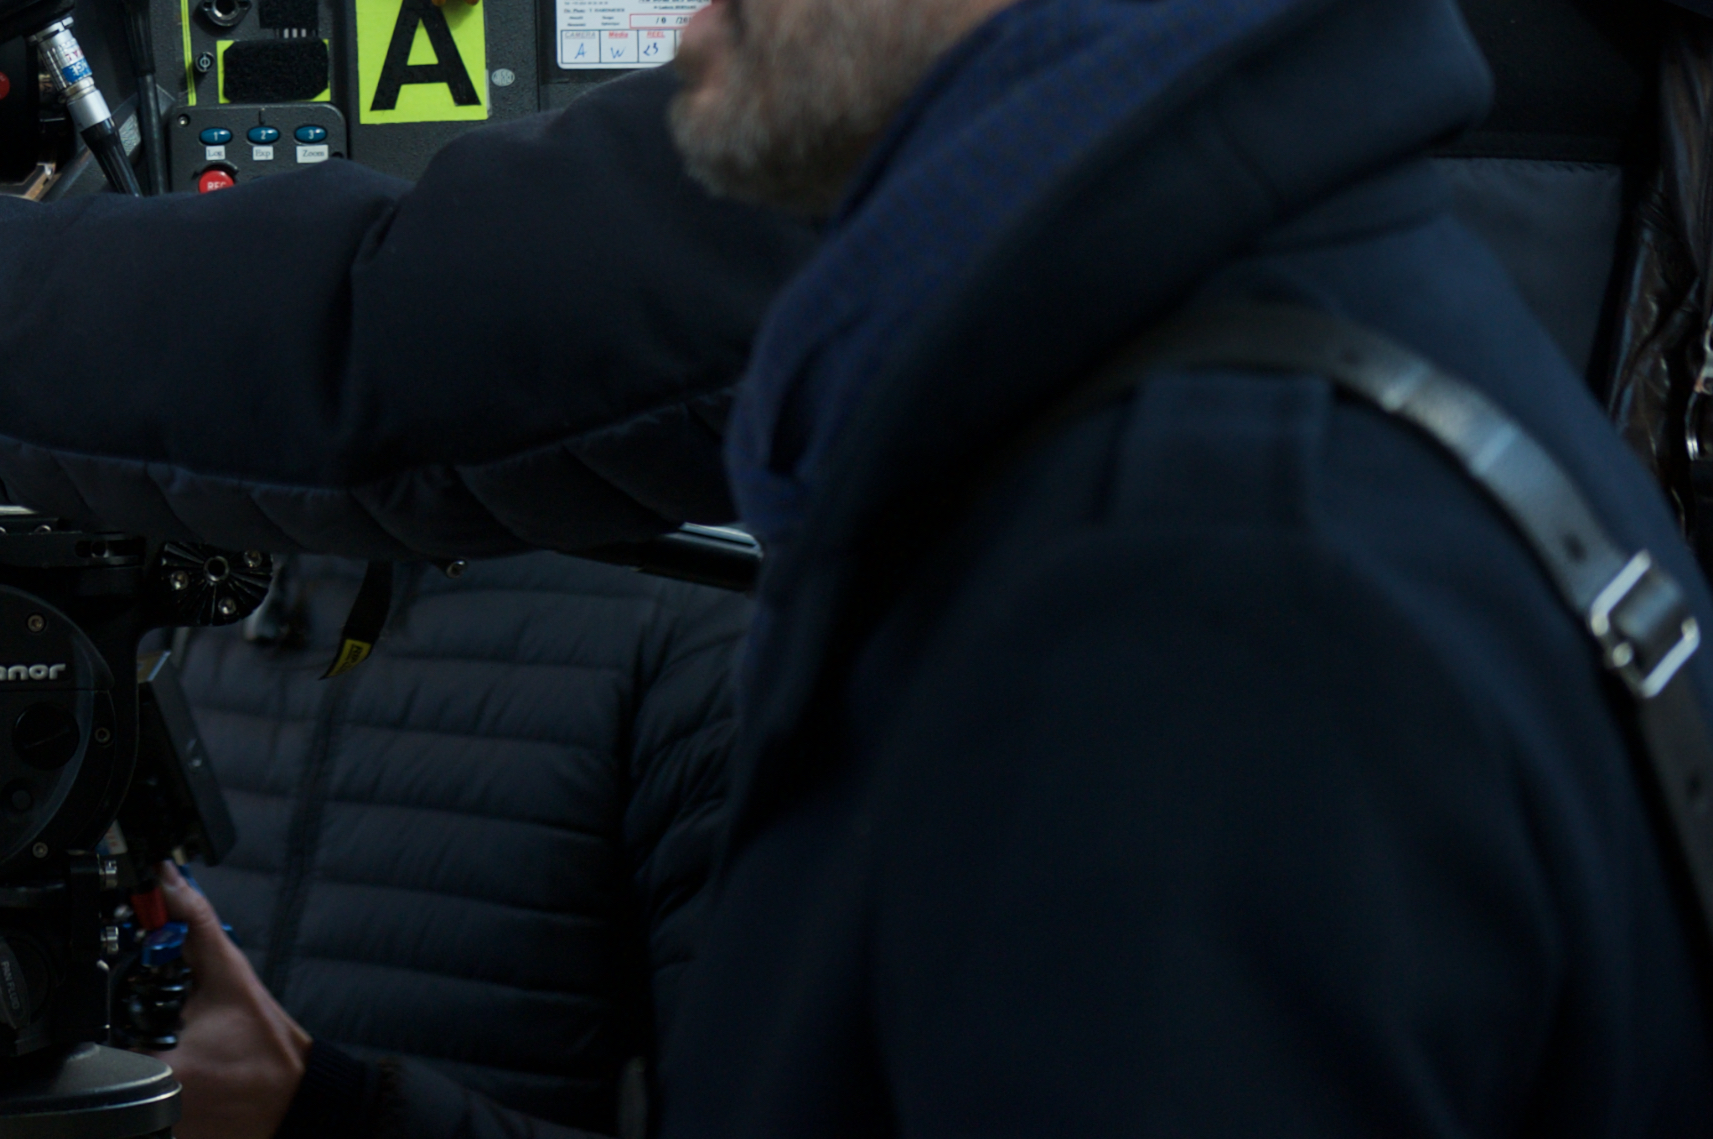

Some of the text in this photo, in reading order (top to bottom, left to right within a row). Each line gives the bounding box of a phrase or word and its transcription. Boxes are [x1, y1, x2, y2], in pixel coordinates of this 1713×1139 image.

[260, 130, 266, 140] 2
[308, 129, 315, 140] 3
[207, 149, 223, 158] Log
[255, 149, 272, 159] Exp
[302, 149, 325, 158] Zoom
